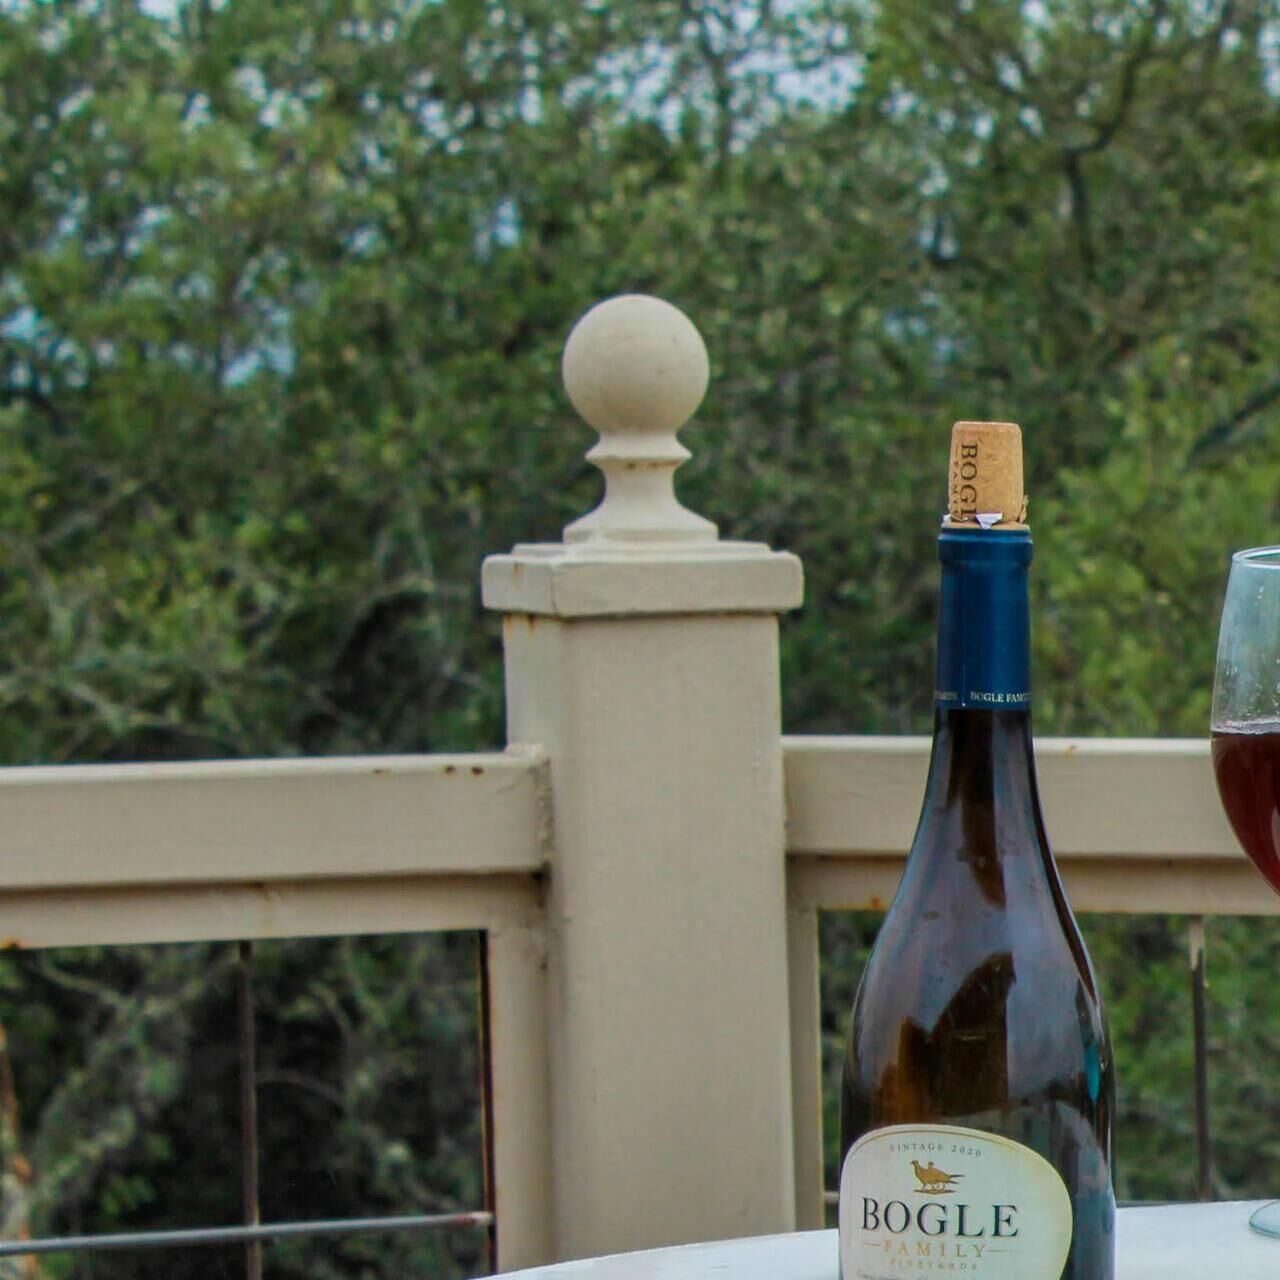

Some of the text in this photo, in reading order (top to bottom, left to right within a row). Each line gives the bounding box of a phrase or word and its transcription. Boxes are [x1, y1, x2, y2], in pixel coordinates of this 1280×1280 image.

[970, 692, 1004, 703] BOGLE
[889, 1143, 981, 1157] VINTAGE 2020
[862, 1197, 1020, 1238] BOGLE
[883, 1239, 986, 1258] FAMILY
